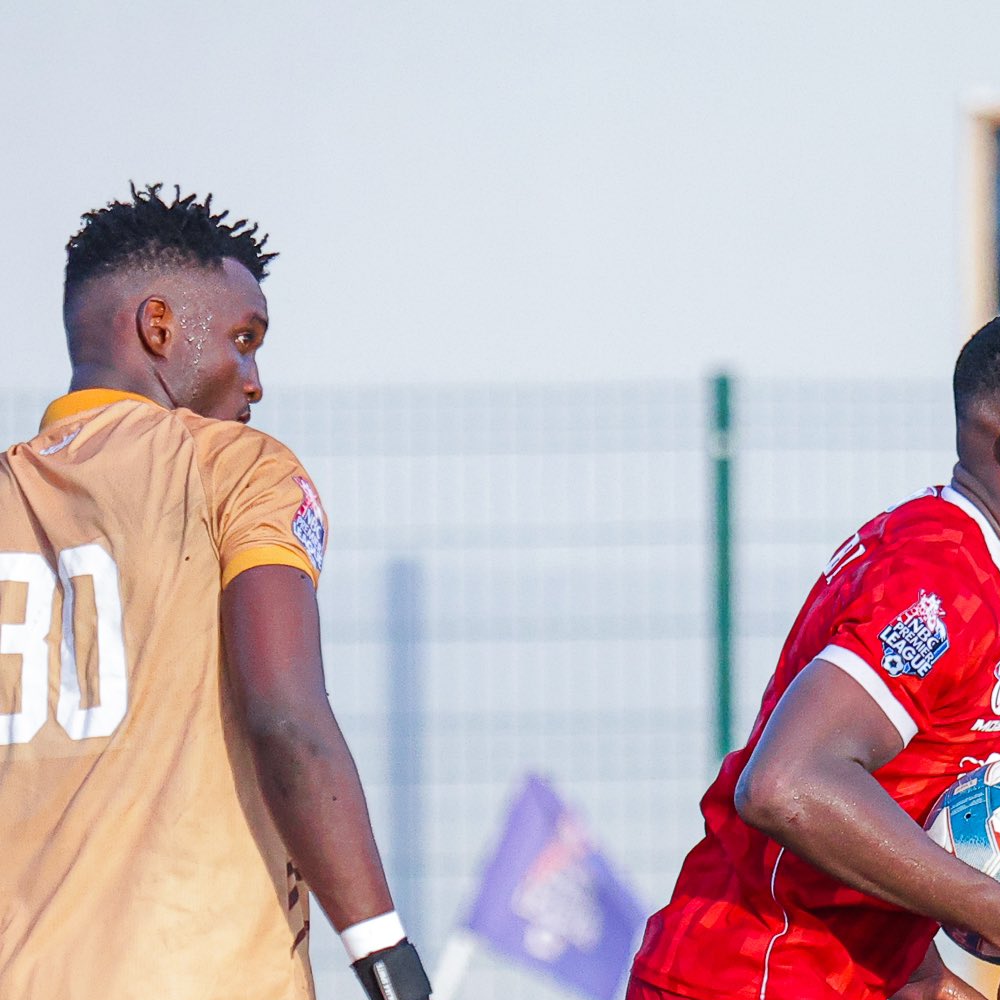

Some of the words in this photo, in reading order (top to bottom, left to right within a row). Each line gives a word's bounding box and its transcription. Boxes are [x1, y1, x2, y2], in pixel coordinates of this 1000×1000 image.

[0, 543, 128, 746] 30
[880, 626, 932, 677] LEAGUE
[893, 622, 934, 663] PREMIER
[908, 617, 939, 649] NBC
